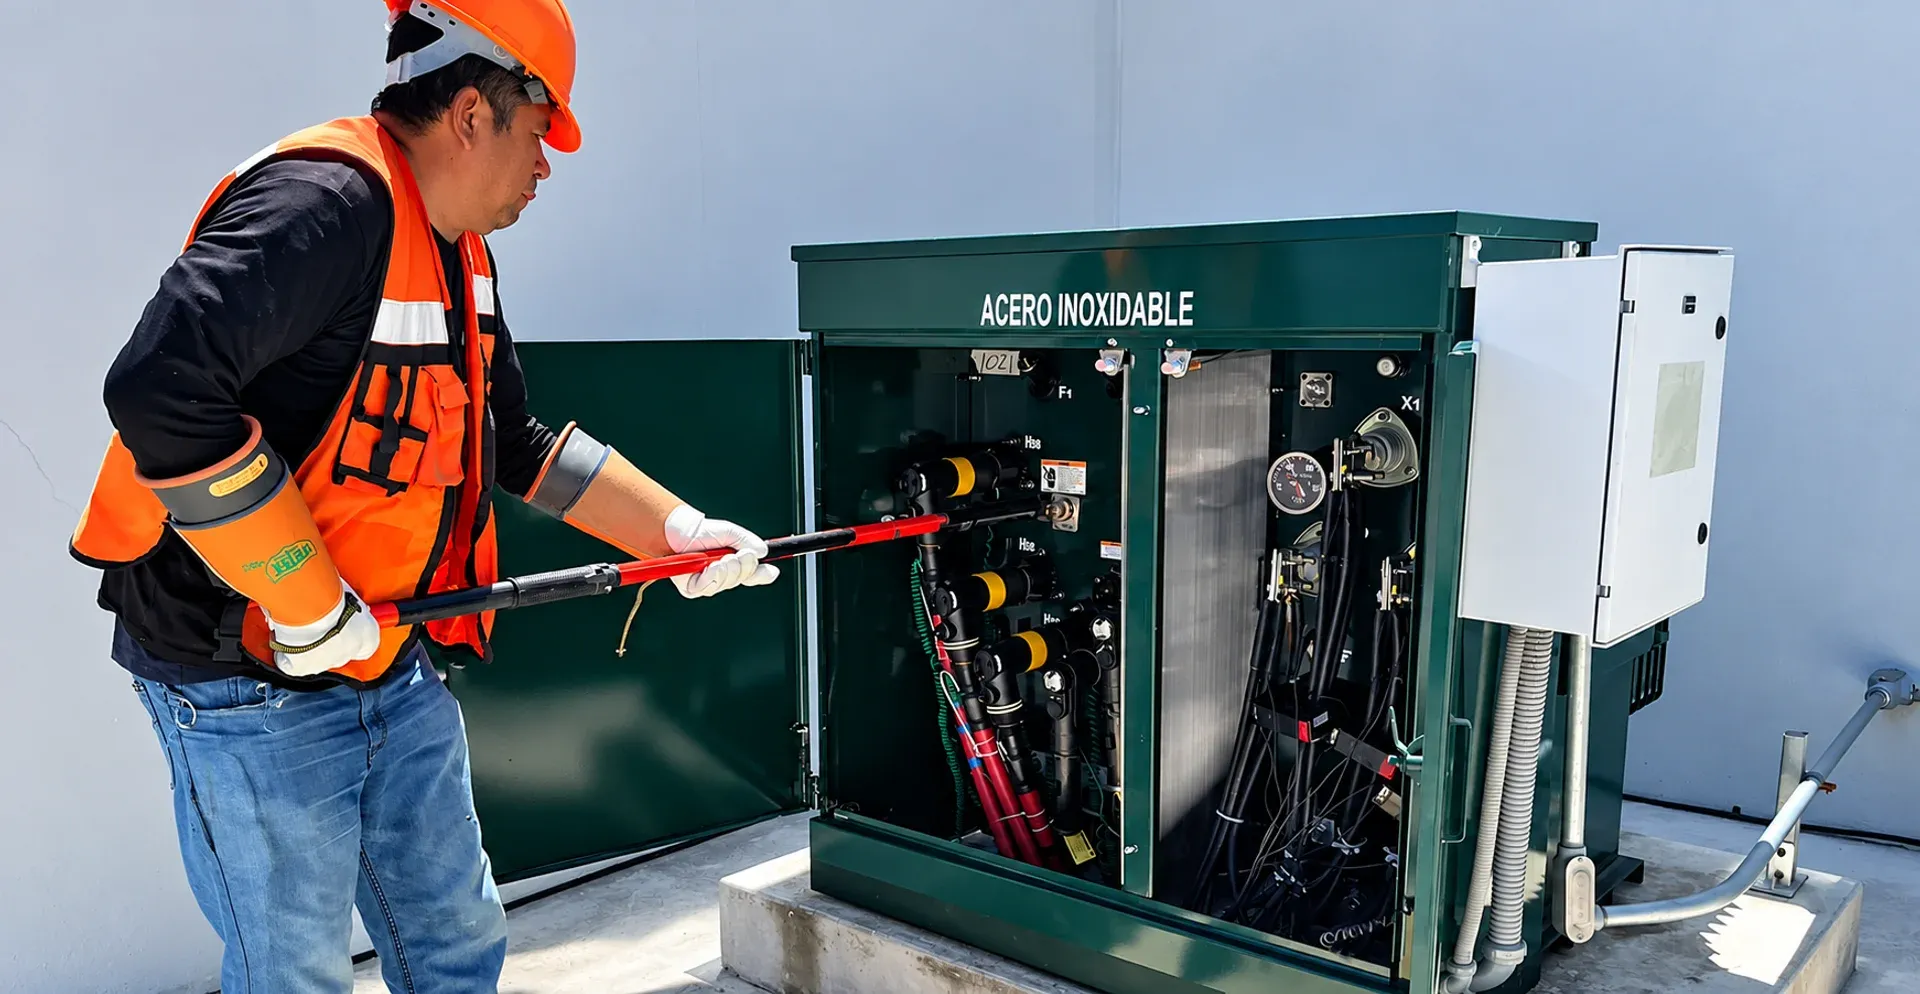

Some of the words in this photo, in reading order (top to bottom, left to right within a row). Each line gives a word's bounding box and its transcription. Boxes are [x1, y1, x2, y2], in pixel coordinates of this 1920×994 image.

[980, 293, 1052, 327] ACERO
[1058, 291, 1194, 327] INOXIDABLE
[980, 352, 1013, 374] 1021
[1058, 385, 1072, 399] F1
[1401, 395, 1420, 411] X1
